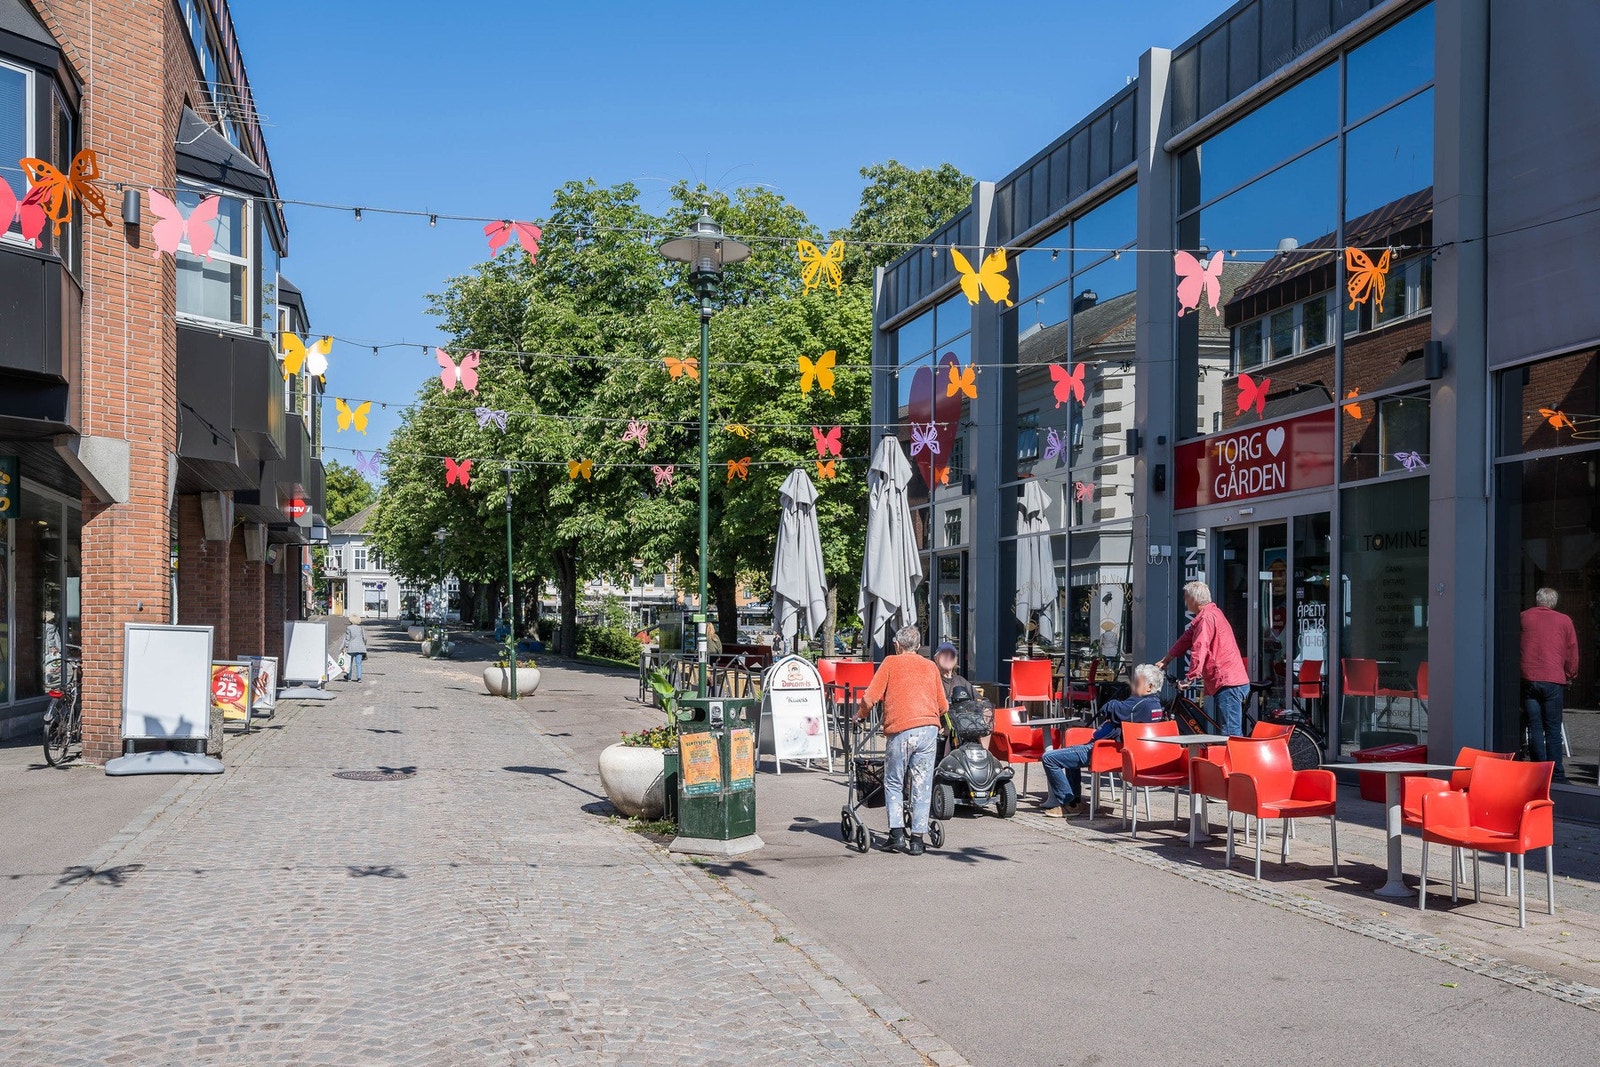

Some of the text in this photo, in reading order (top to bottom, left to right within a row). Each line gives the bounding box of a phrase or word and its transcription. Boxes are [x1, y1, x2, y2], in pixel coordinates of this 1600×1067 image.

[1214, 432, 1262, 467] TORG
[1214, 461, 1286, 499] GÅRDEN
[1363, 529, 1428, 551] TOMINE
[1297, 601, 1327, 617] ÅPENT
